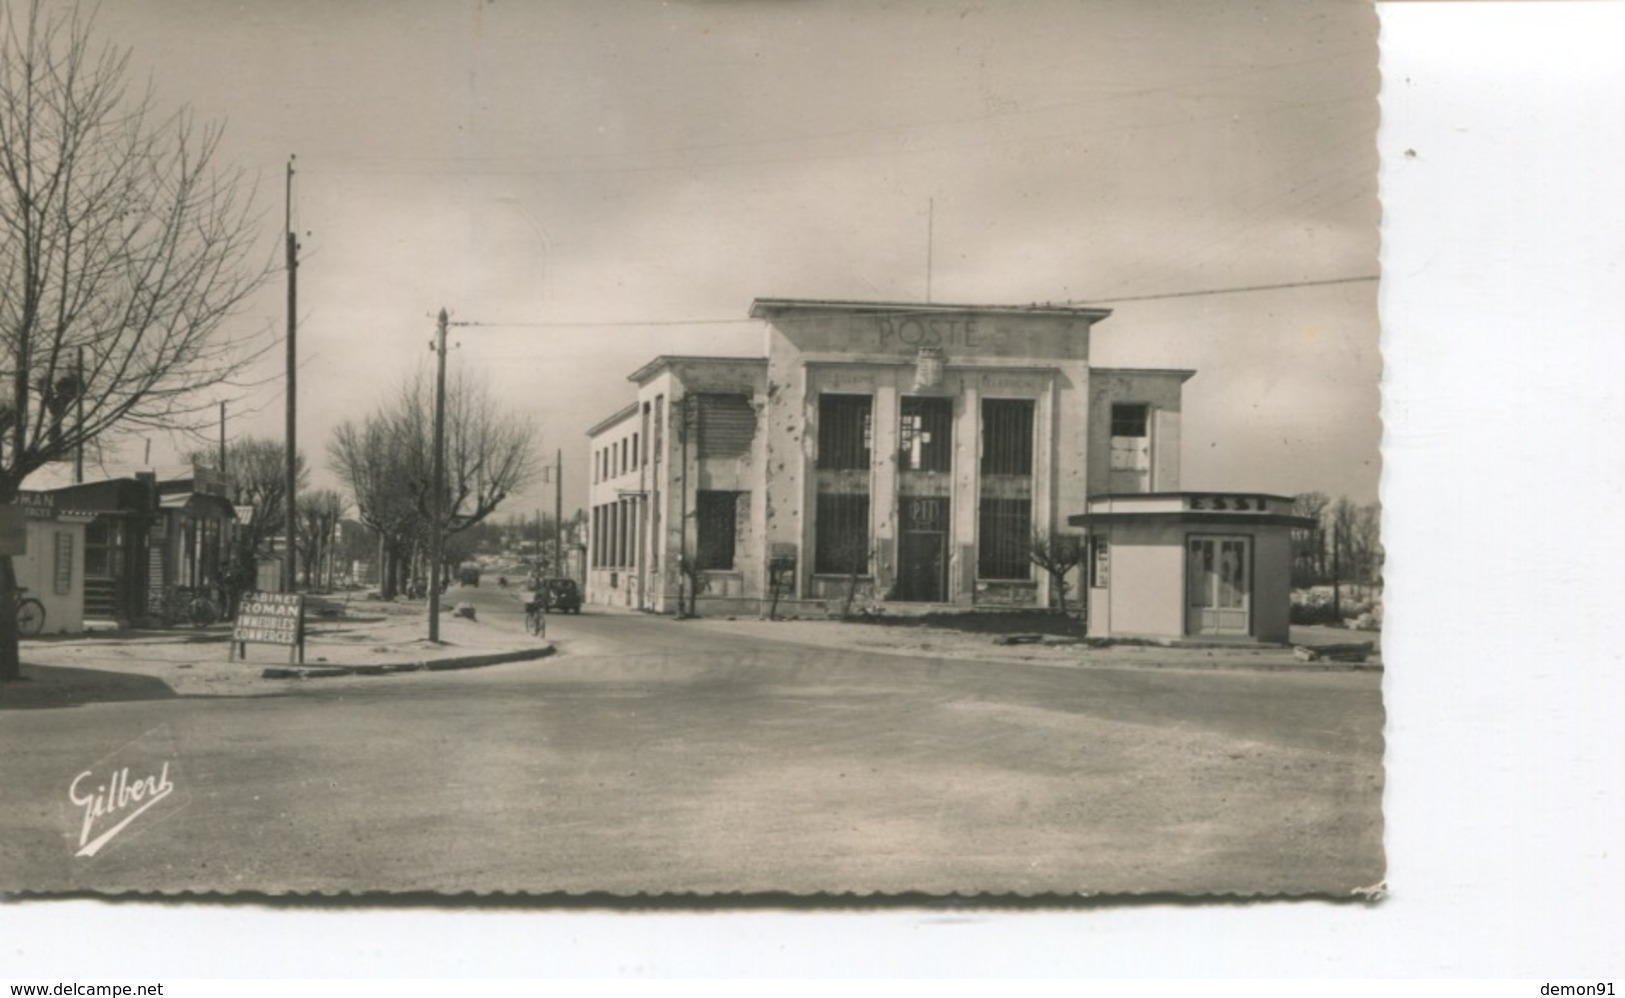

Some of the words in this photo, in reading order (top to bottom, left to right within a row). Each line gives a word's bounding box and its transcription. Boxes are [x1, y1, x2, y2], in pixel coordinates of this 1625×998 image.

[876, 317, 978, 347] POSTE
[243, 591, 299, 605] CABINET
[239, 601, 299, 617] ROMAN
[234, 628, 295, 643] COMMERCES
